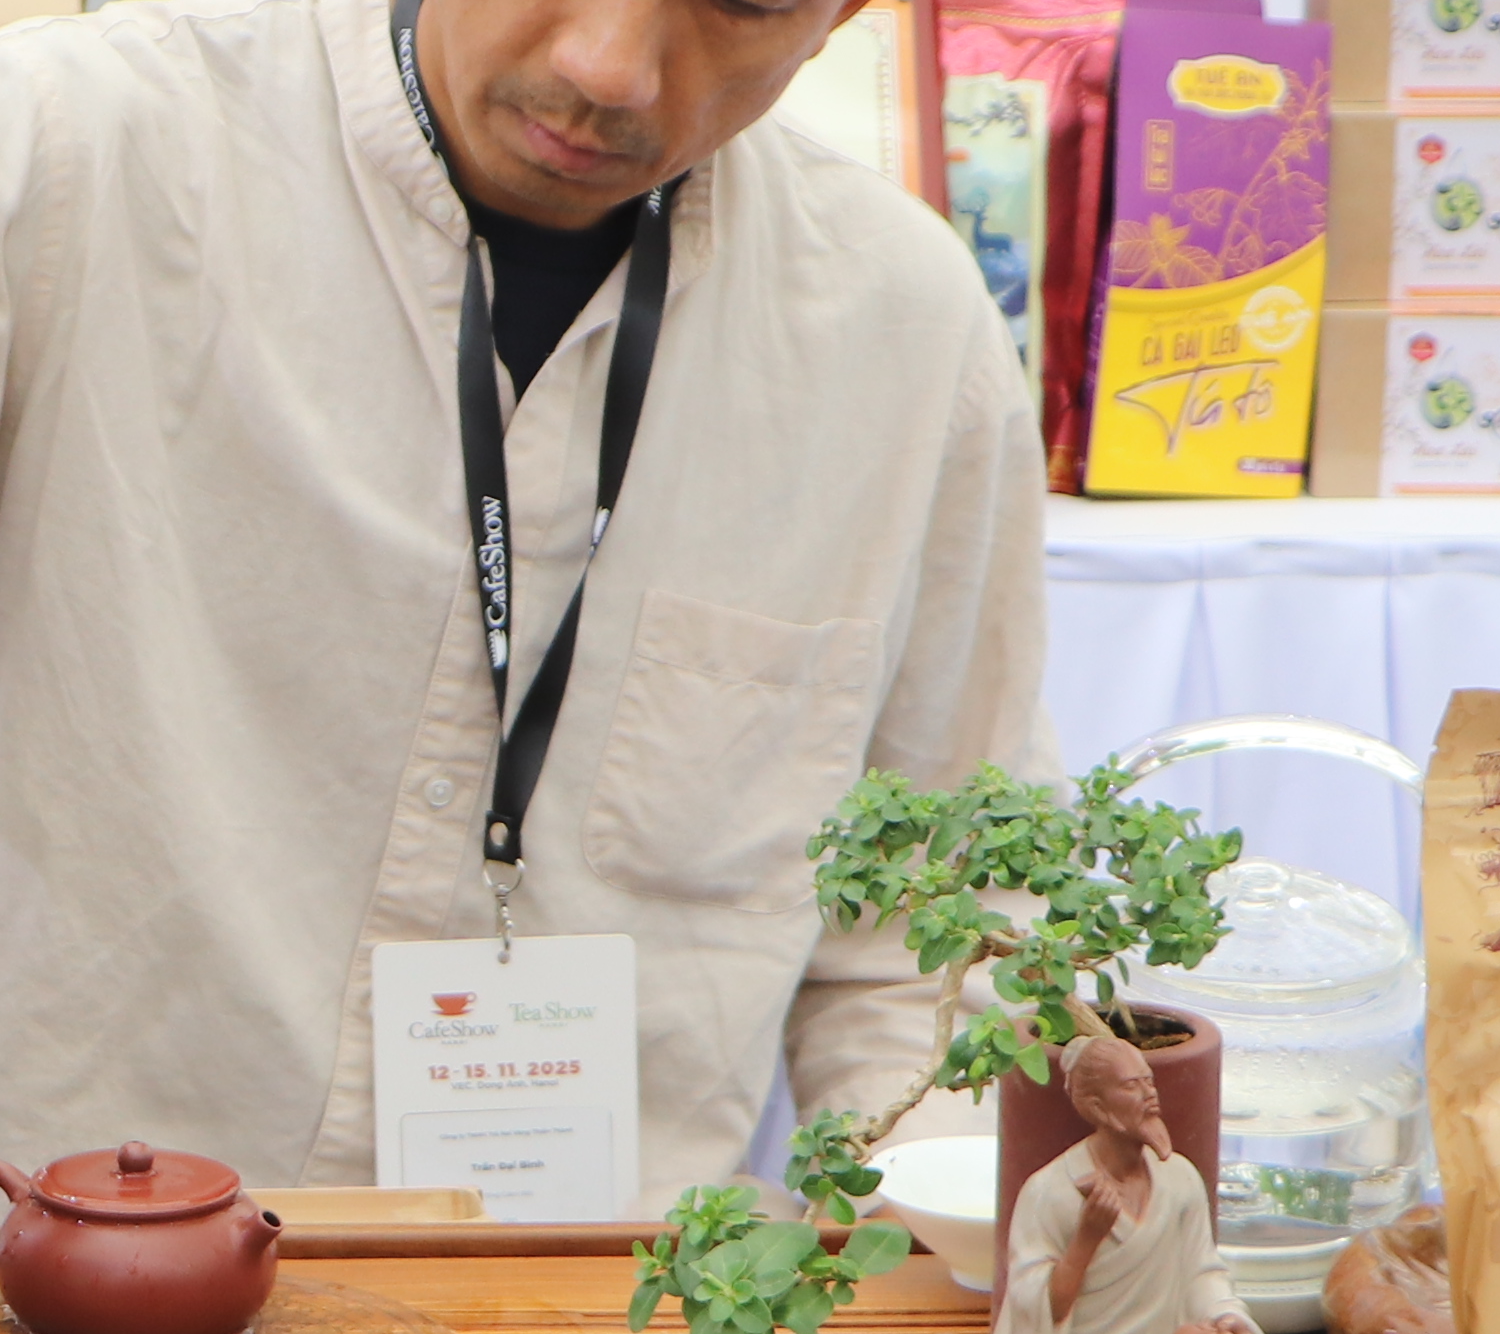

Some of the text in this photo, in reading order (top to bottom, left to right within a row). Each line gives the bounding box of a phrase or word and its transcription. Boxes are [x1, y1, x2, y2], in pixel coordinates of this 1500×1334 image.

[478, 495, 508, 628] CafeShow
[409, 1019, 499, 1040] CafeShow
[527, 1059, 582, 1078] 2025
